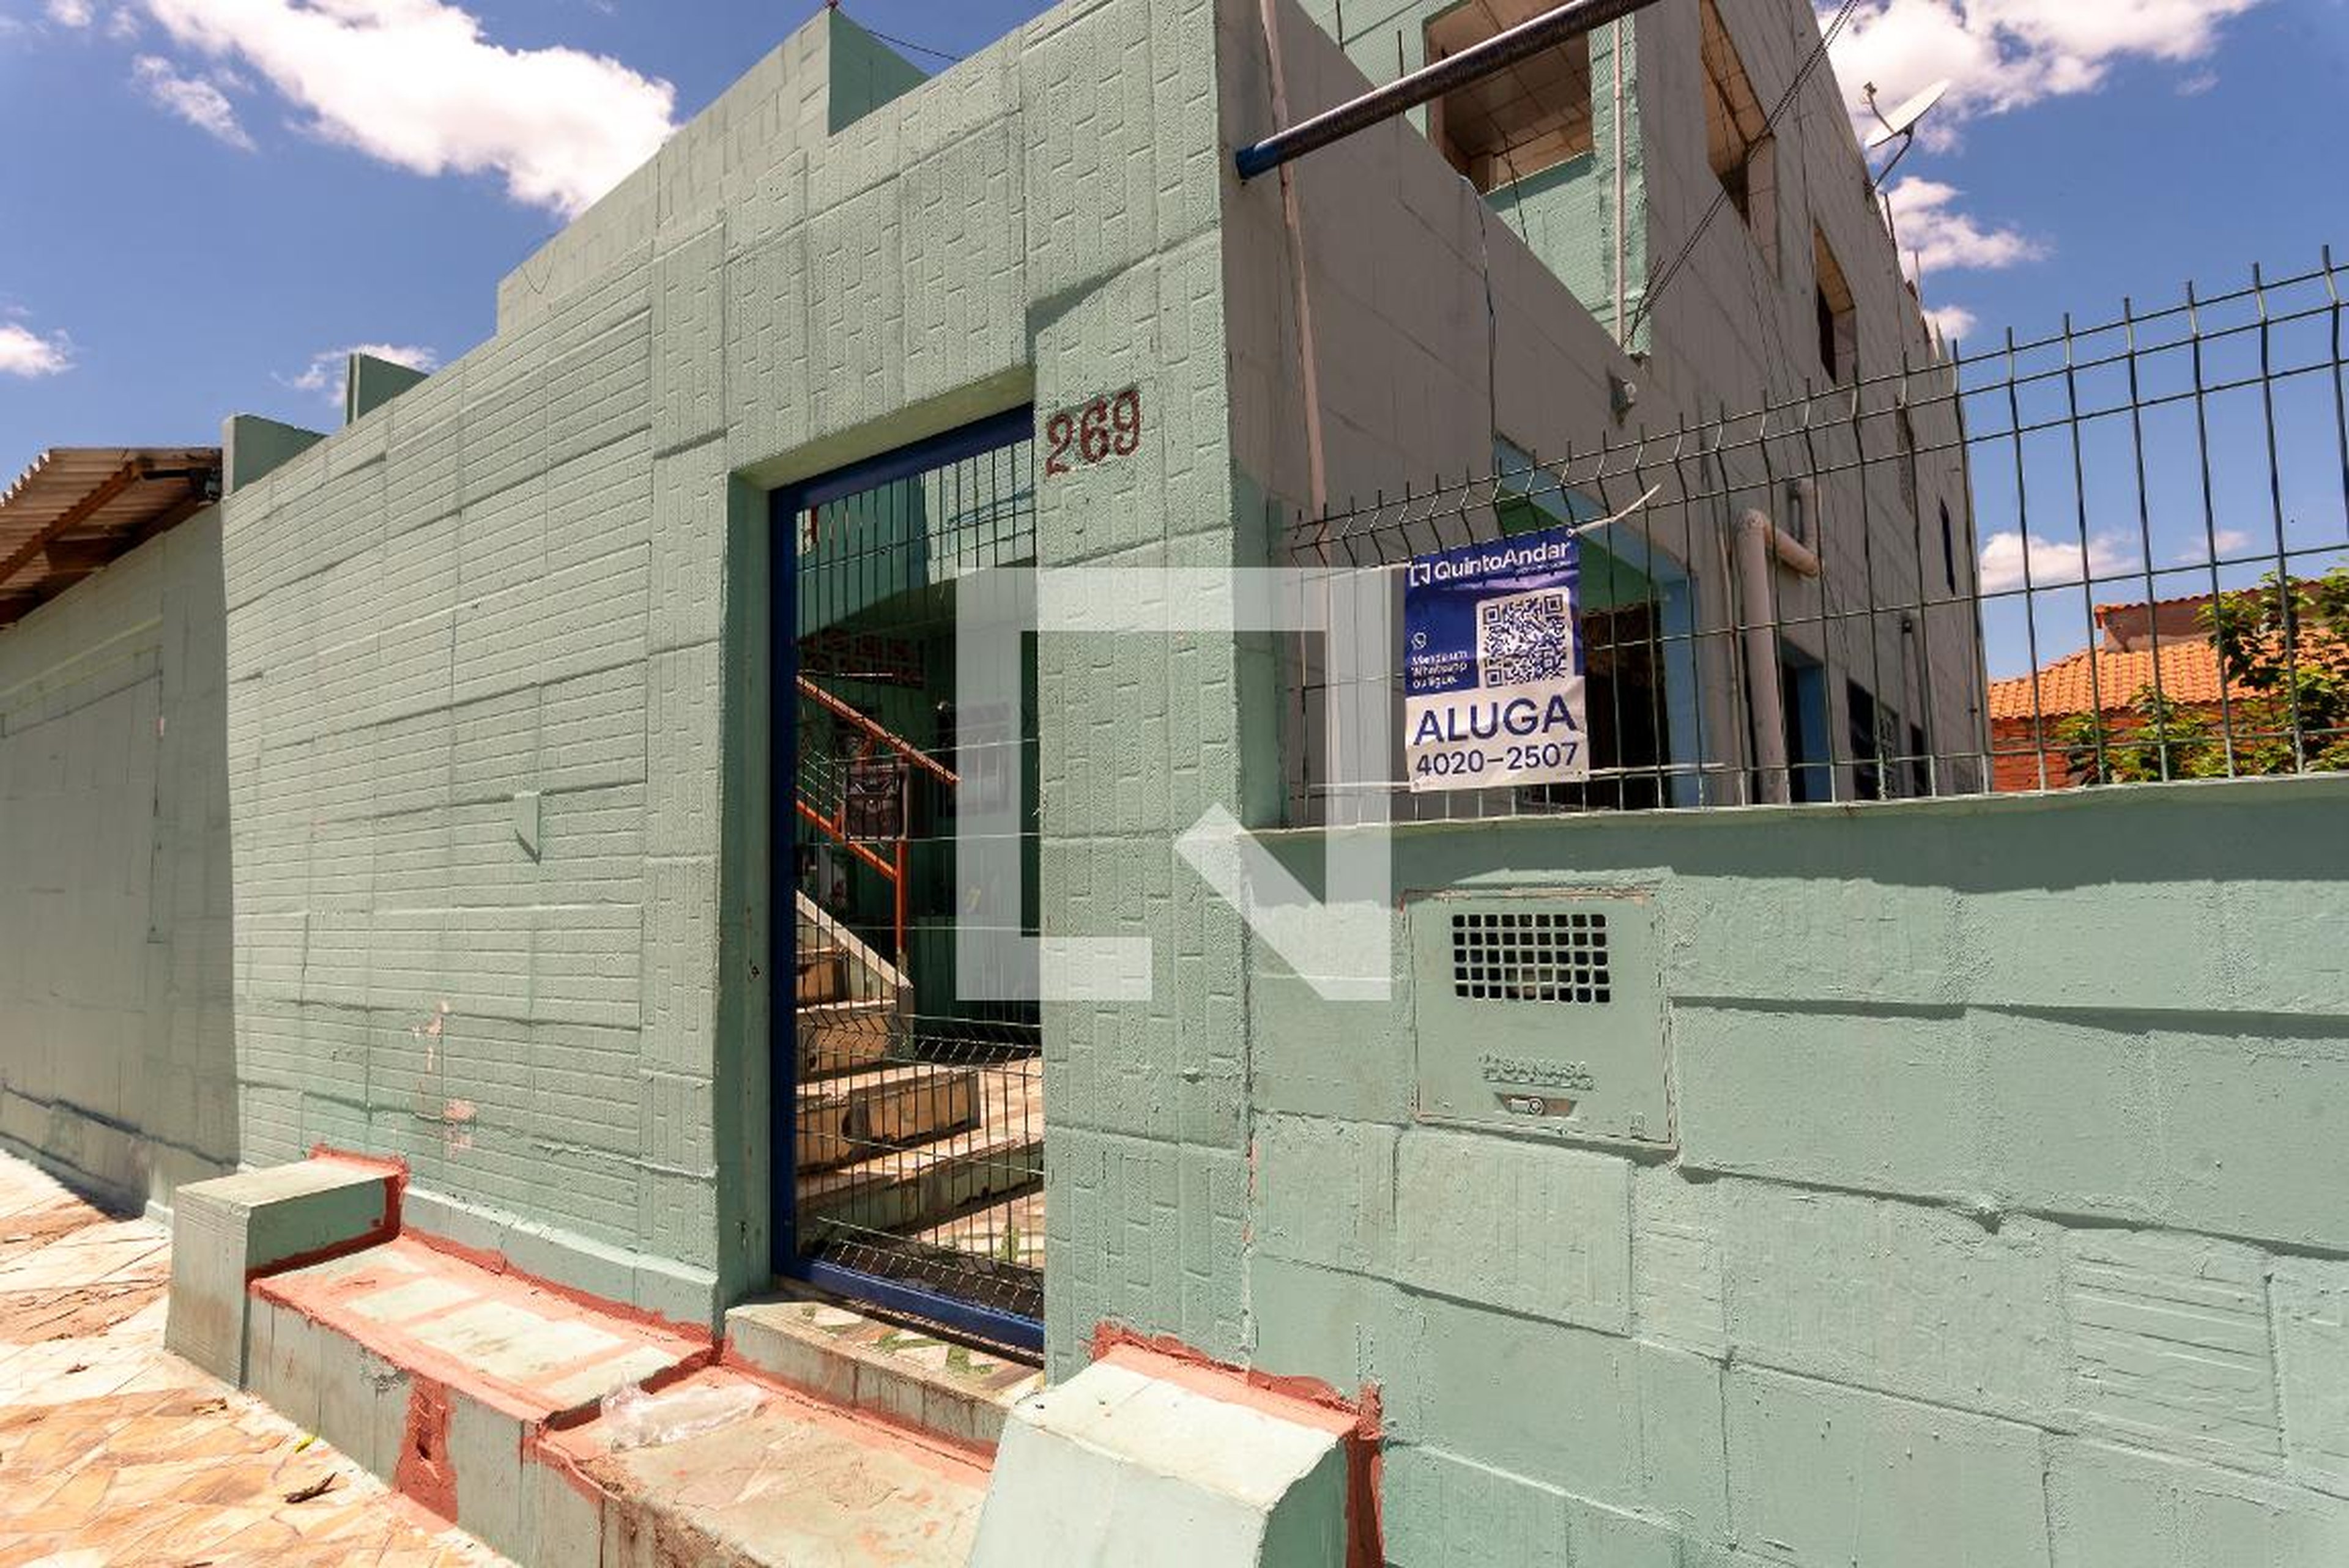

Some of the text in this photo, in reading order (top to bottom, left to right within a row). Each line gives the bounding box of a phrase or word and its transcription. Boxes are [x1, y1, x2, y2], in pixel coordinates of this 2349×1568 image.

[1045, 390, 1140, 476] 269
[1434, 543, 1570, 580] QuintoAndar
[1414, 695, 1577, 745] ALUGA
[1417, 743, 1578, 776] 4020-2507
